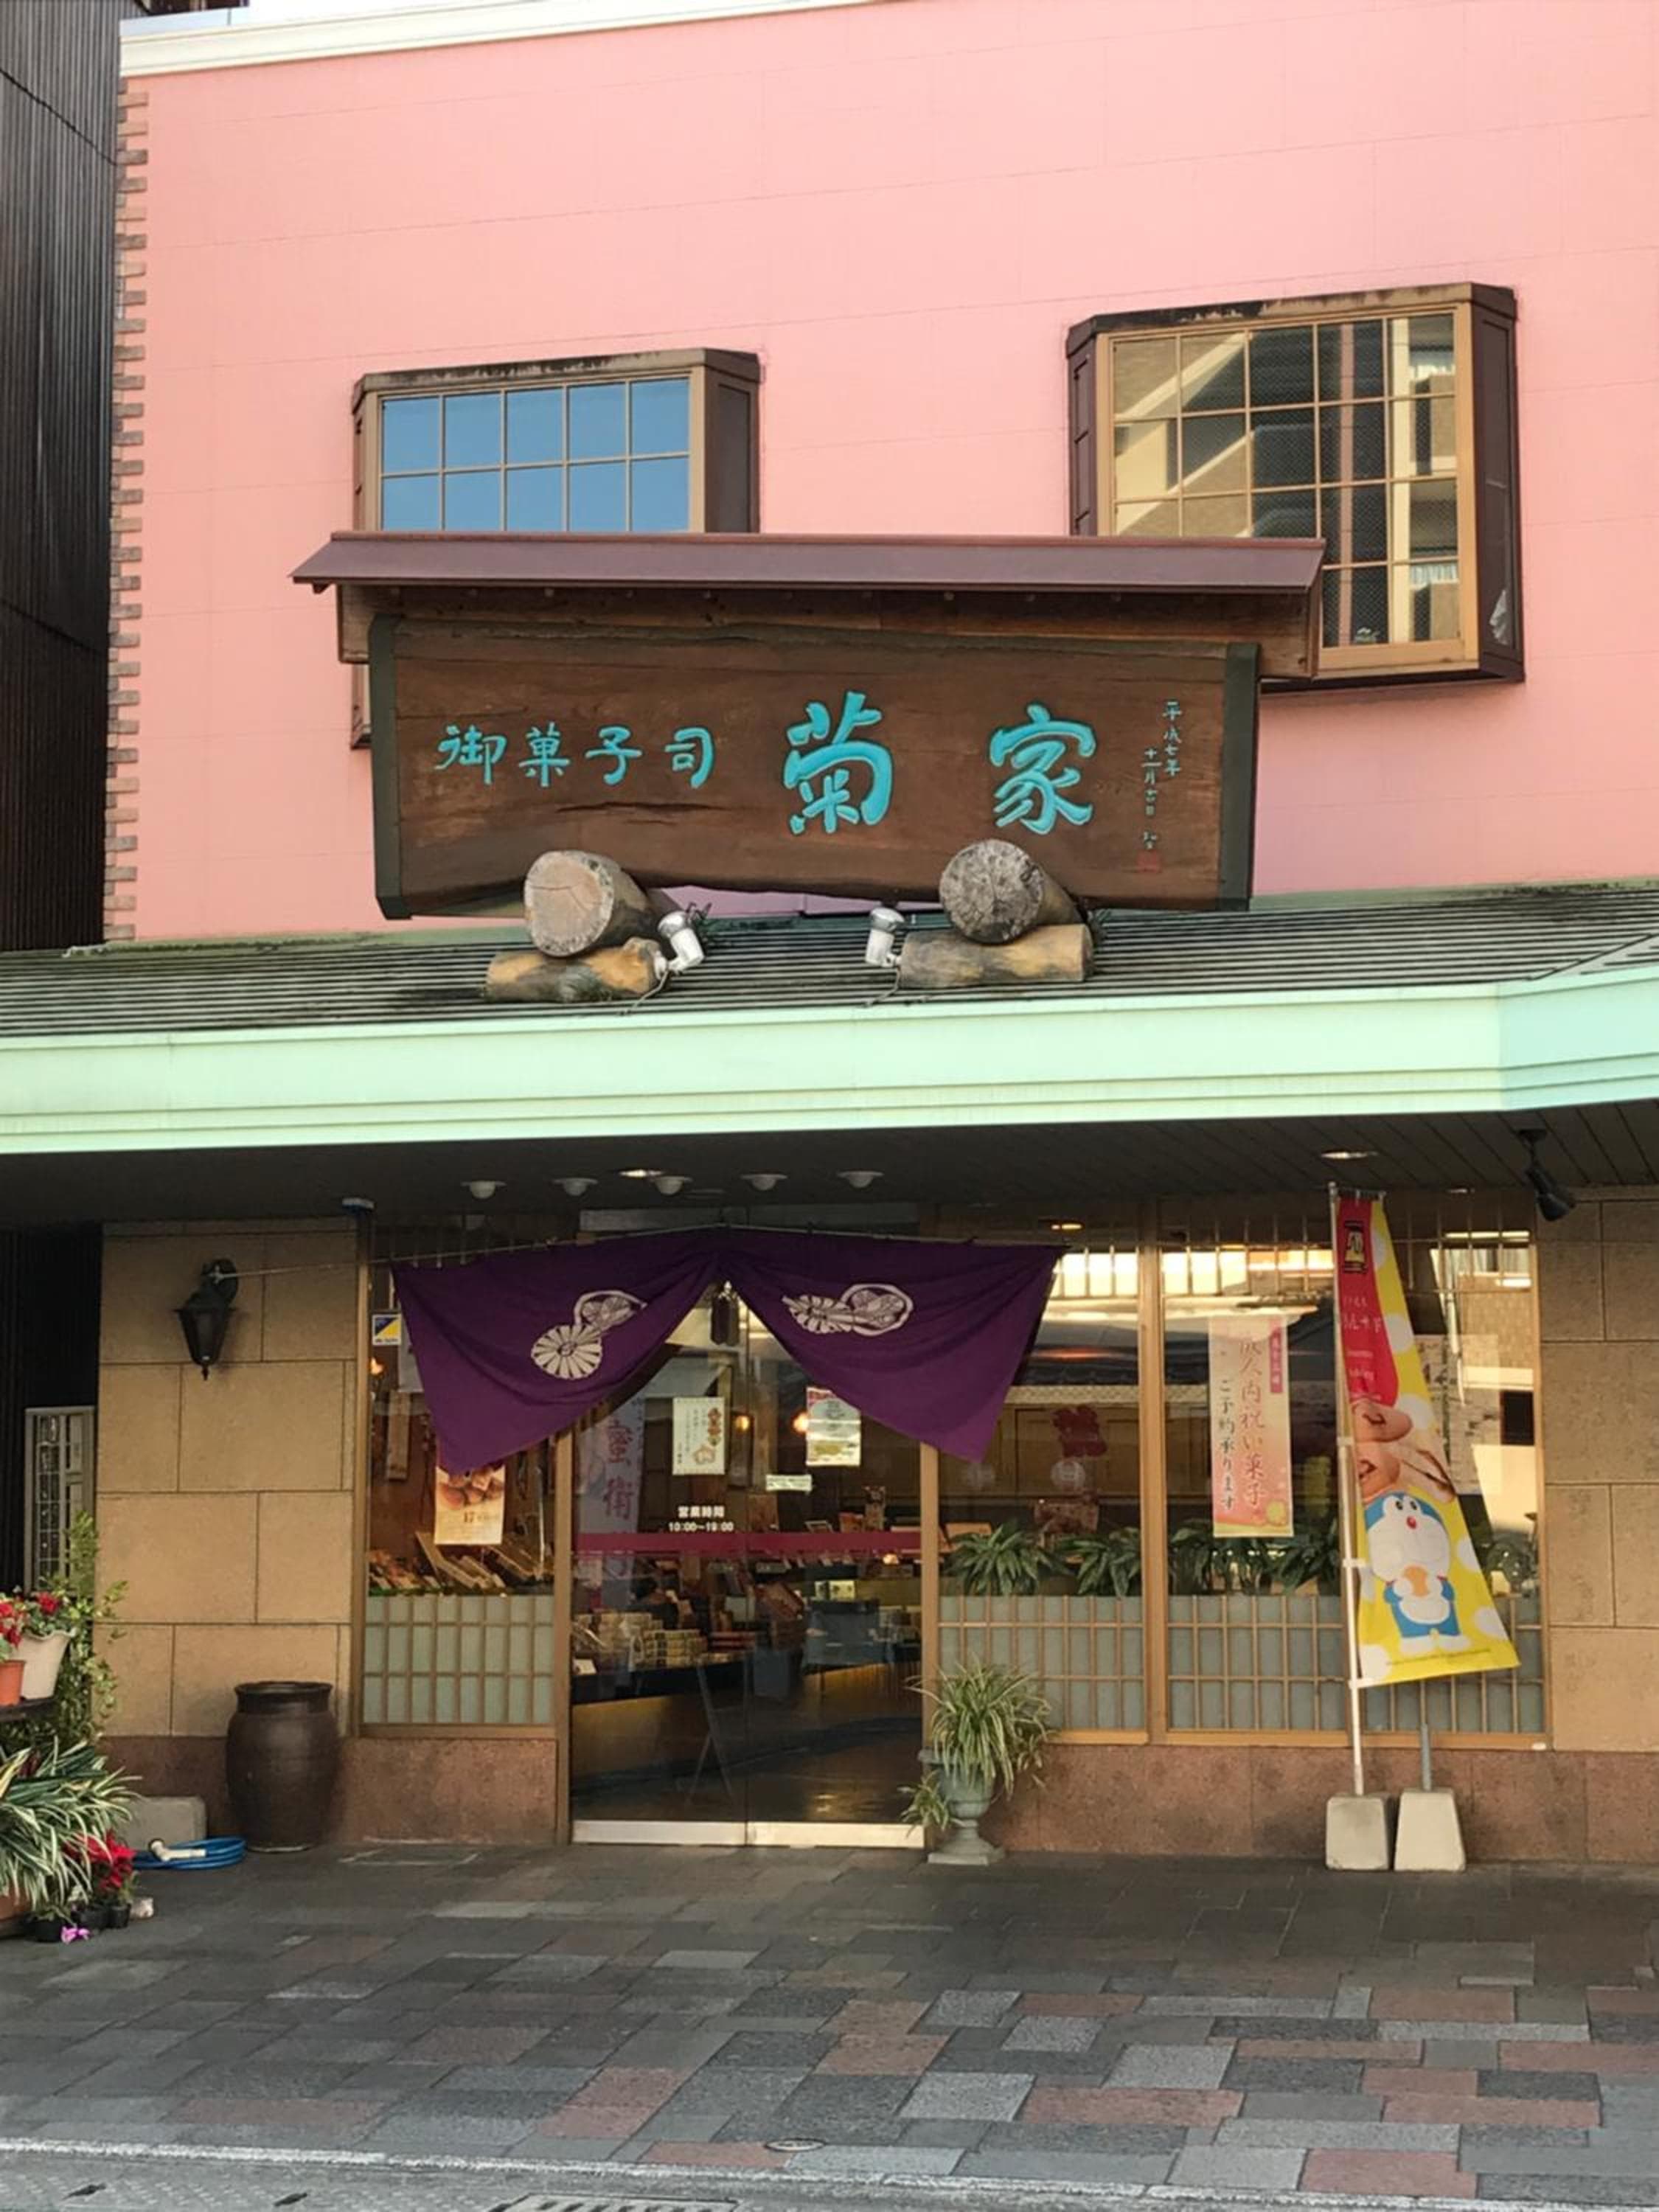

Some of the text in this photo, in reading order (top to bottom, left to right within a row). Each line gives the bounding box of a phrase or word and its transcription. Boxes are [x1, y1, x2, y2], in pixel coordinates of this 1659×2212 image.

[434, 690, 1095, 835] 御菓子司 菊家
[678, 1505, 725, 1519] 営業時間
